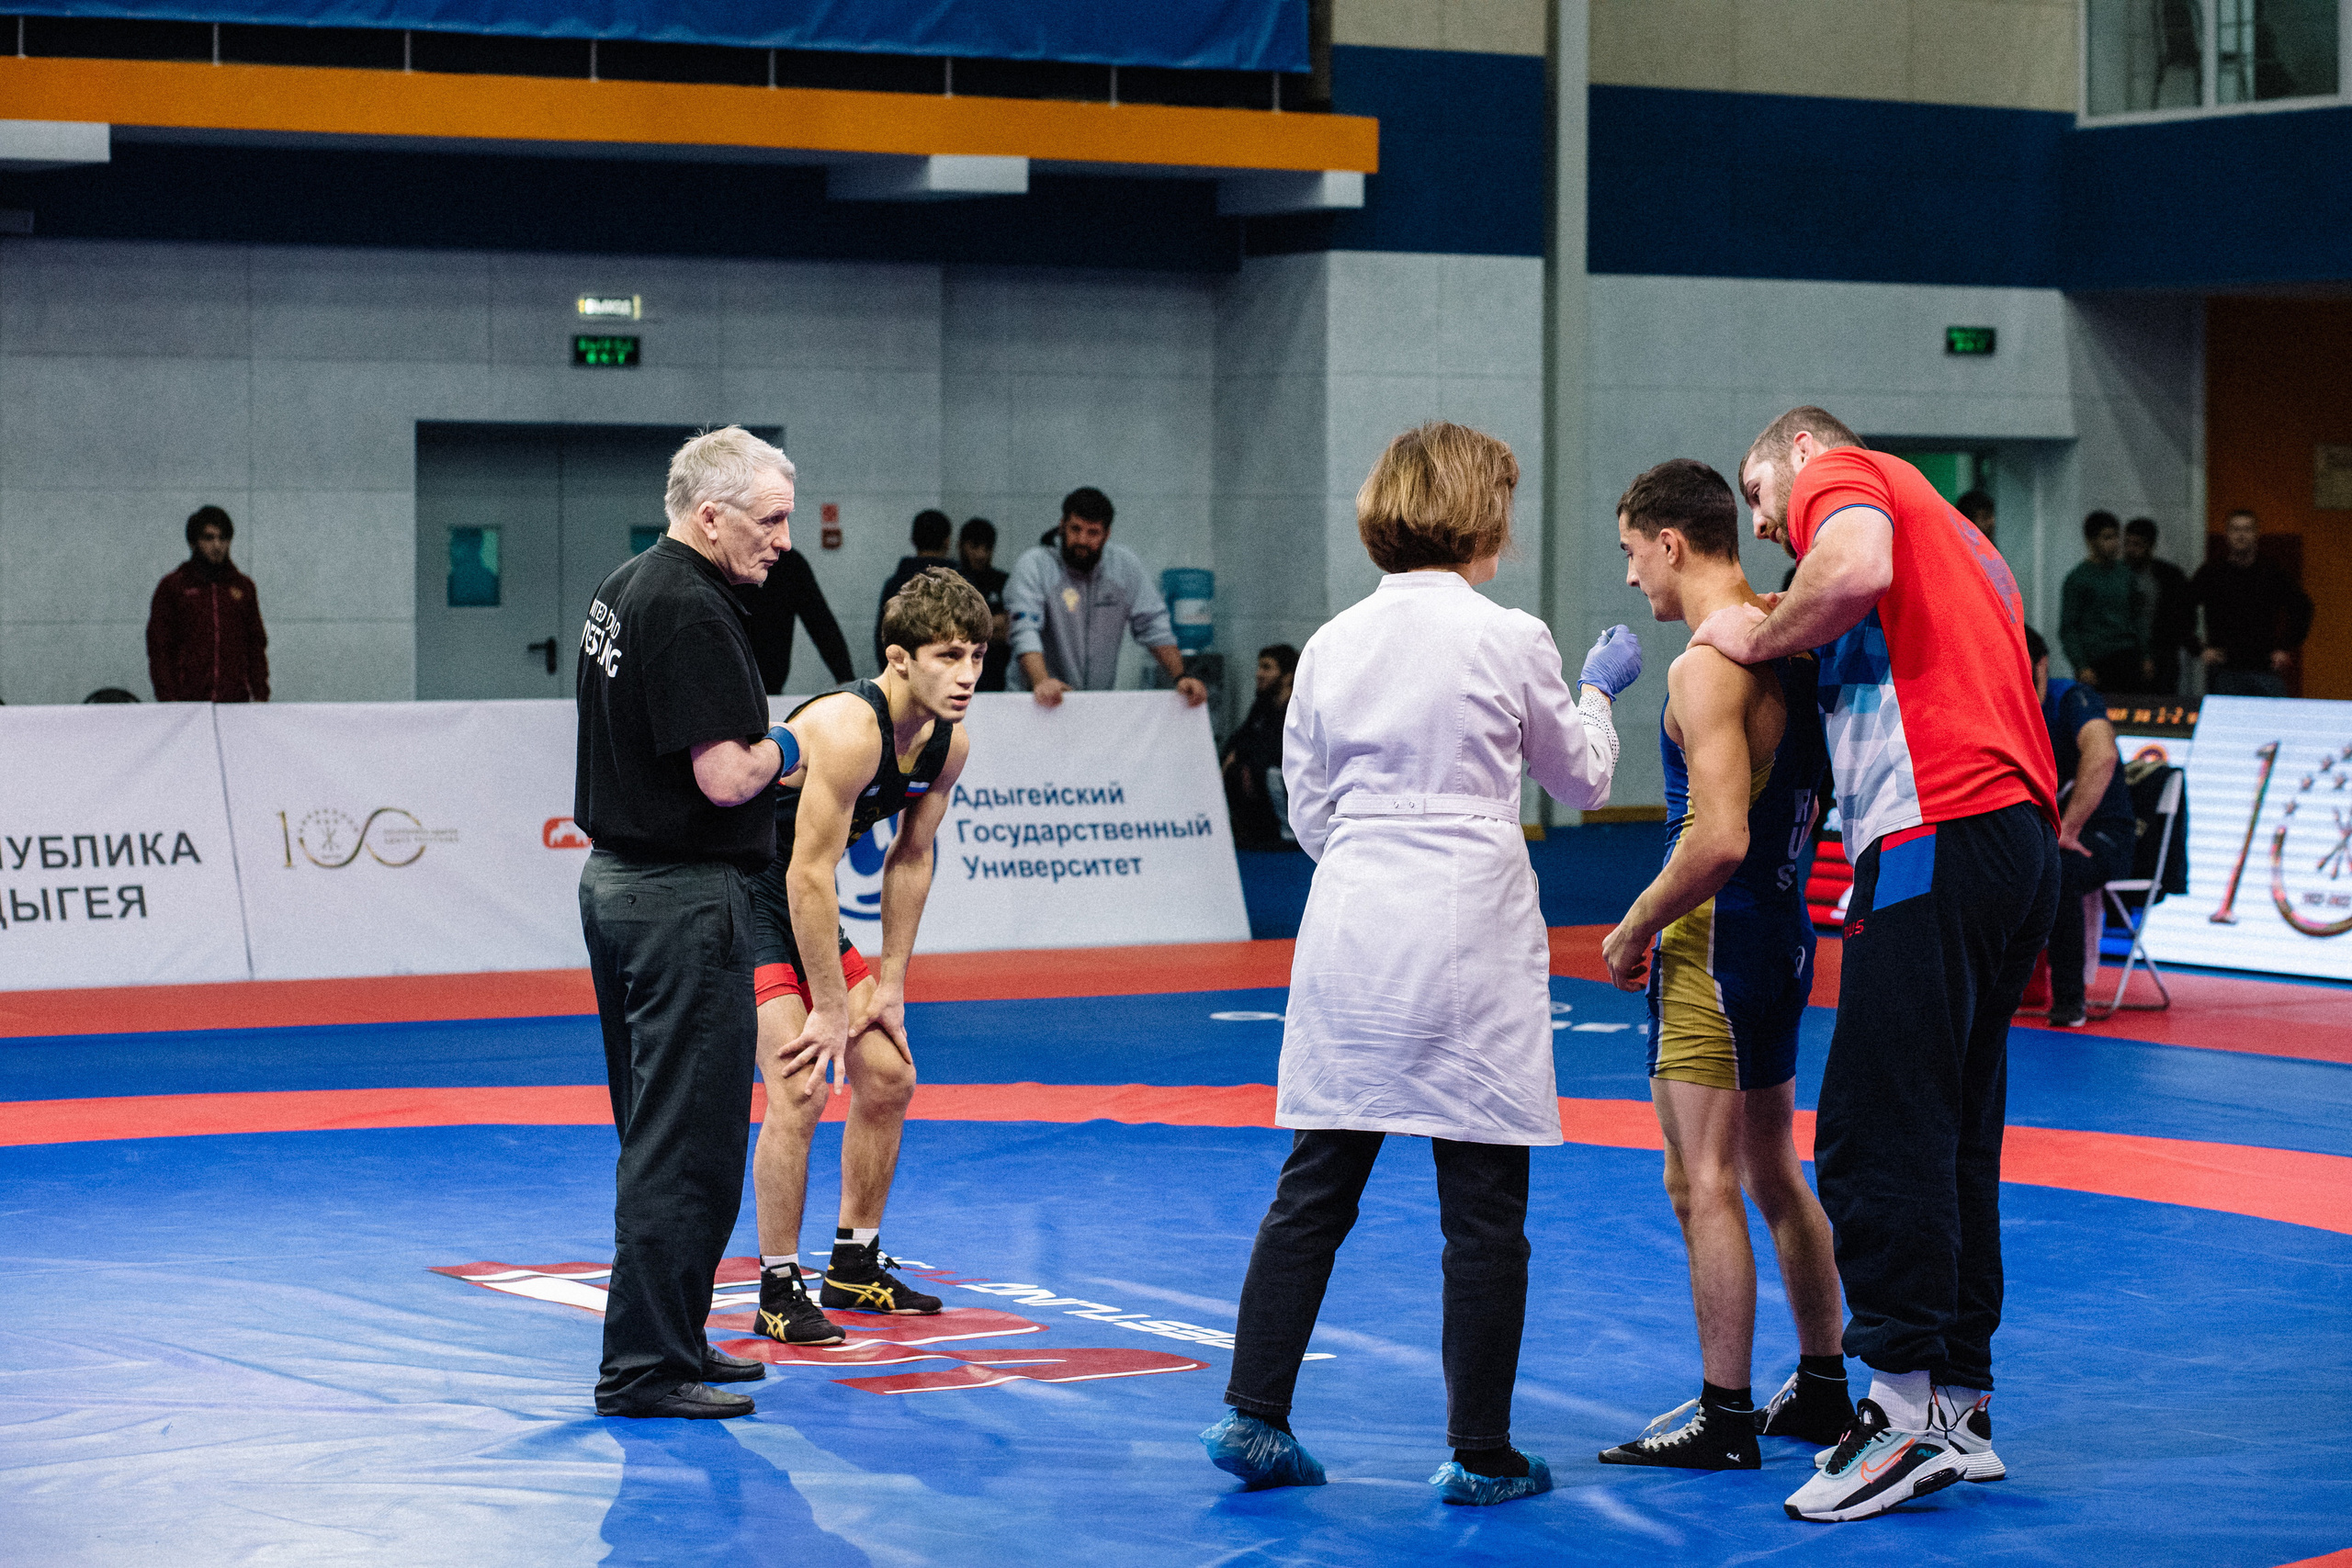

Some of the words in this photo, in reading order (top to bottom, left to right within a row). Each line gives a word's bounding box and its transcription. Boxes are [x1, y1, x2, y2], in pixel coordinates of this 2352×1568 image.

[952, 782, 1125, 810] Адыгейский
[956, 814, 1213, 849] Государственный
[0, 830, 202, 871] УБЛИКА
[962, 854, 1143, 884] Университет
[1843, 919, 1865, 942] RUS
